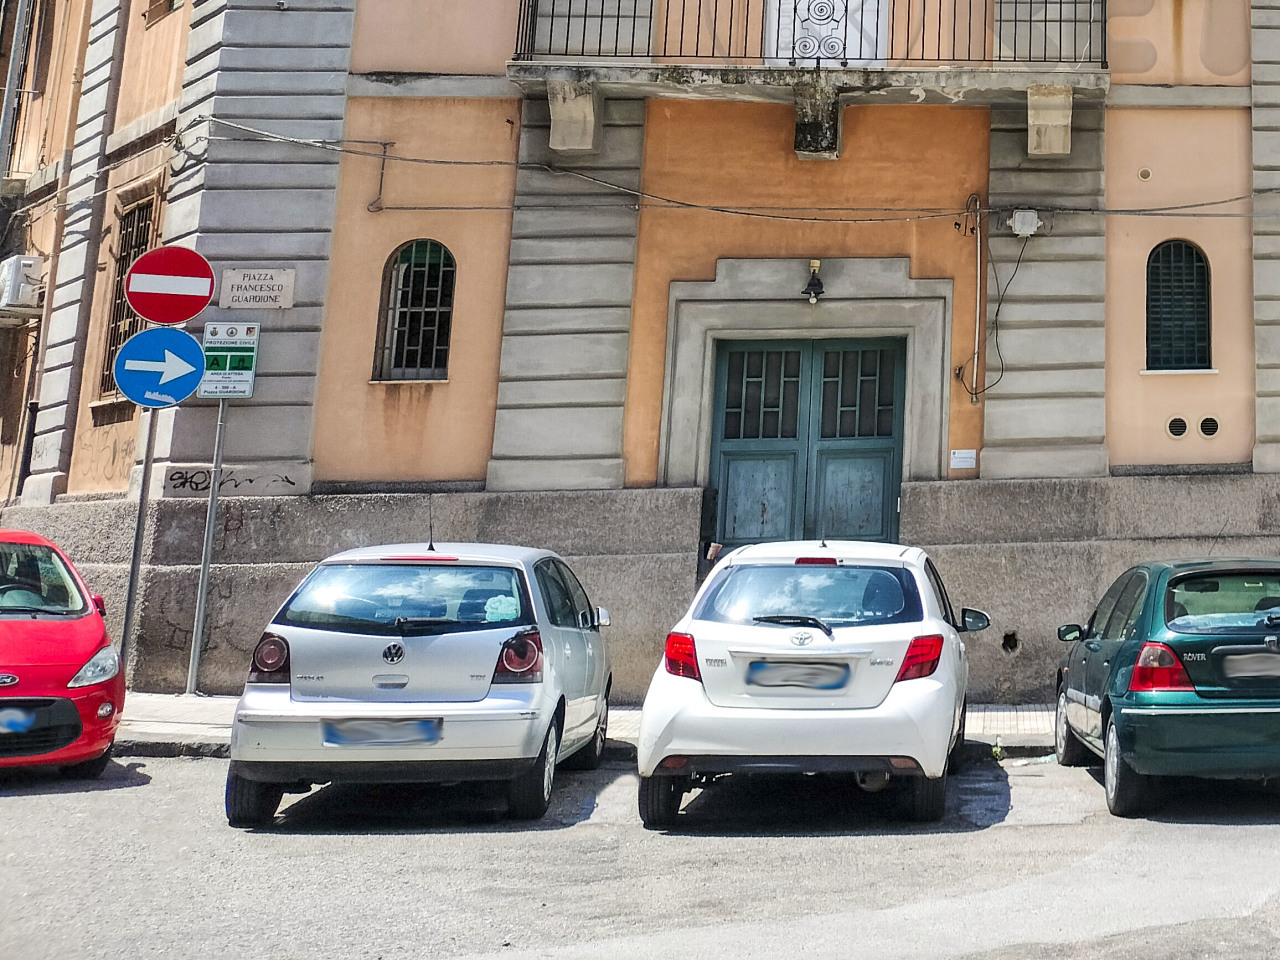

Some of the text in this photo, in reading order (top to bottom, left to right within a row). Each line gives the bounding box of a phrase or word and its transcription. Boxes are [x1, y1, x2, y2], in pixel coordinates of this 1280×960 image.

[242, 273, 274, 281] PIAZZA
[230, 284, 284, 292] FRANCESCO
[231, 295, 281, 303] GUARDIONE
[209, 356, 220, 368] A
[1183, 653, 1207, 661] ROVER
